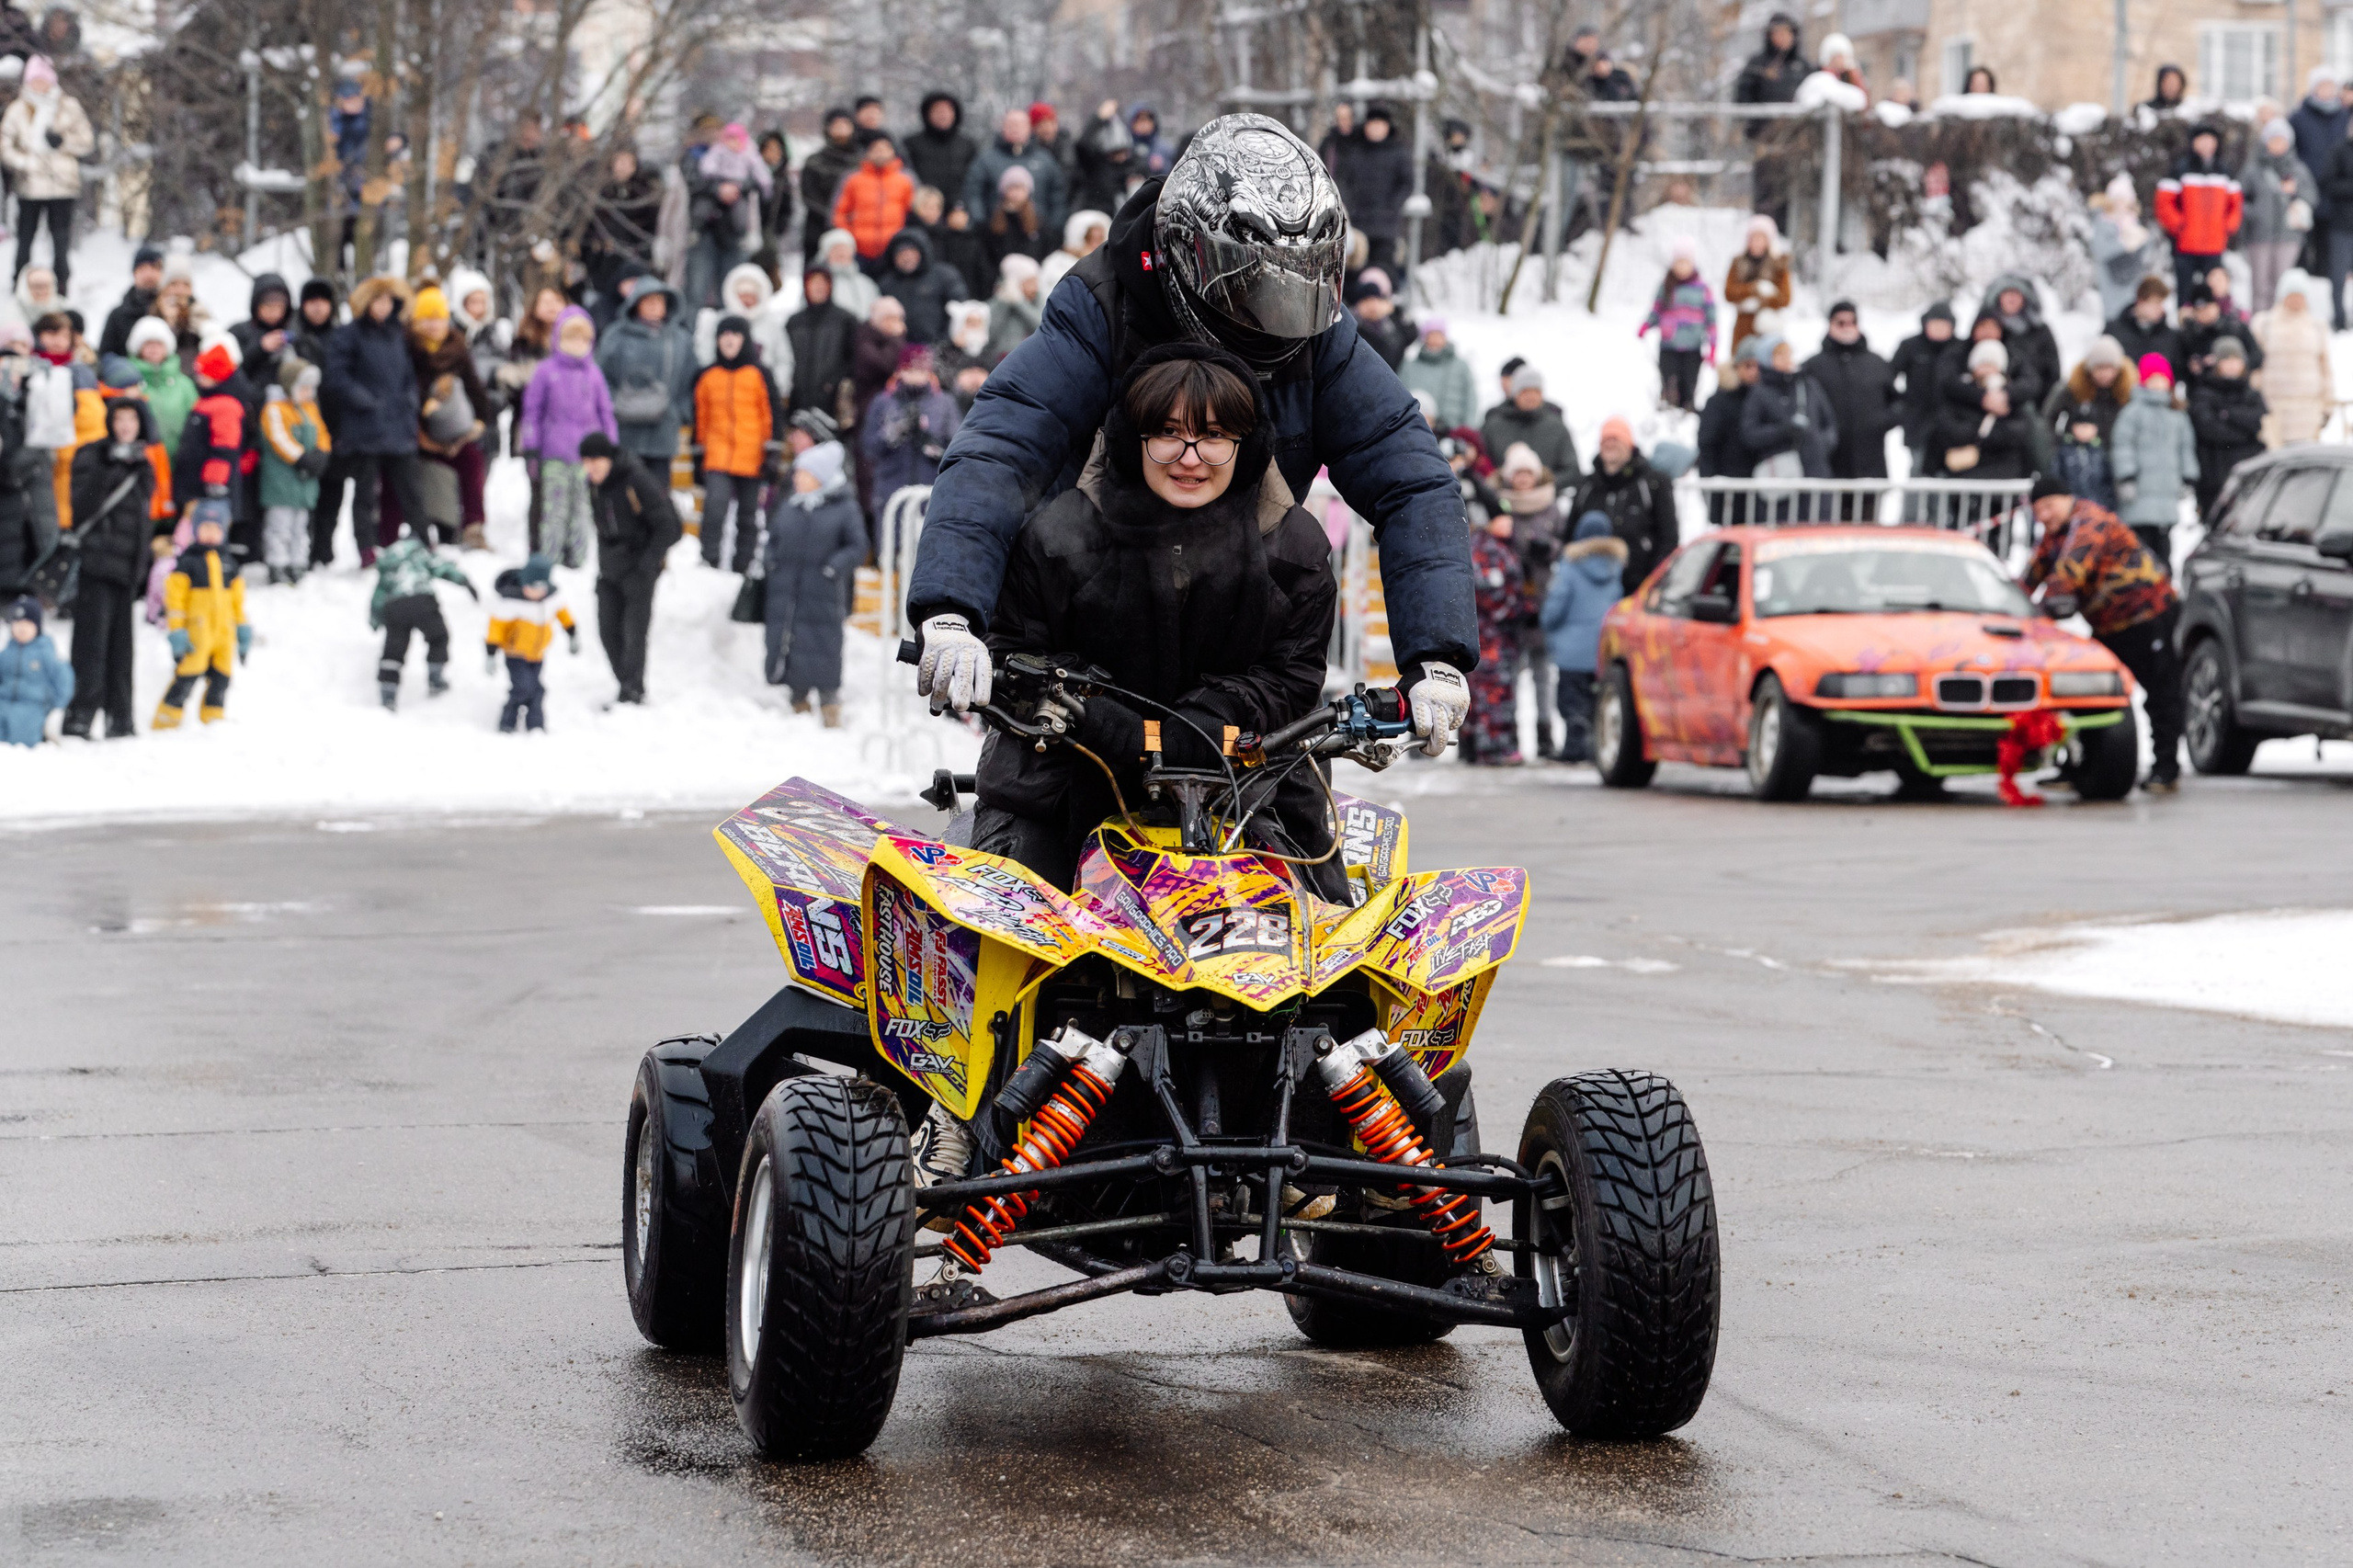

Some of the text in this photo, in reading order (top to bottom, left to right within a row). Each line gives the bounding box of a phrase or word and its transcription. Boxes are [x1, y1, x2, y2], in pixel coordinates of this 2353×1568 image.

[909, 846, 947, 865] VP
[965, 864, 1033, 893] FOX
[1463, 871, 1498, 892] VP
[1116, 891, 1183, 967] GAVGRAPHICS.PRO
[1385, 896, 1436, 941] FOX
[782, 899, 817, 971] AMSOIL
[878, 883, 896, 997] FASTHOUSE
[1188, 911, 1290, 960] 228
[1407, 934, 1442, 966] AMSOIL
[905, 917, 923, 1007] AMSOIL
[1233, 972, 1276, 983] GAV
[884, 1017, 927, 1040] FOX
[1400, 1029, 1435, 1046] FOX
[911, 1052, 955, 1069] GAV
